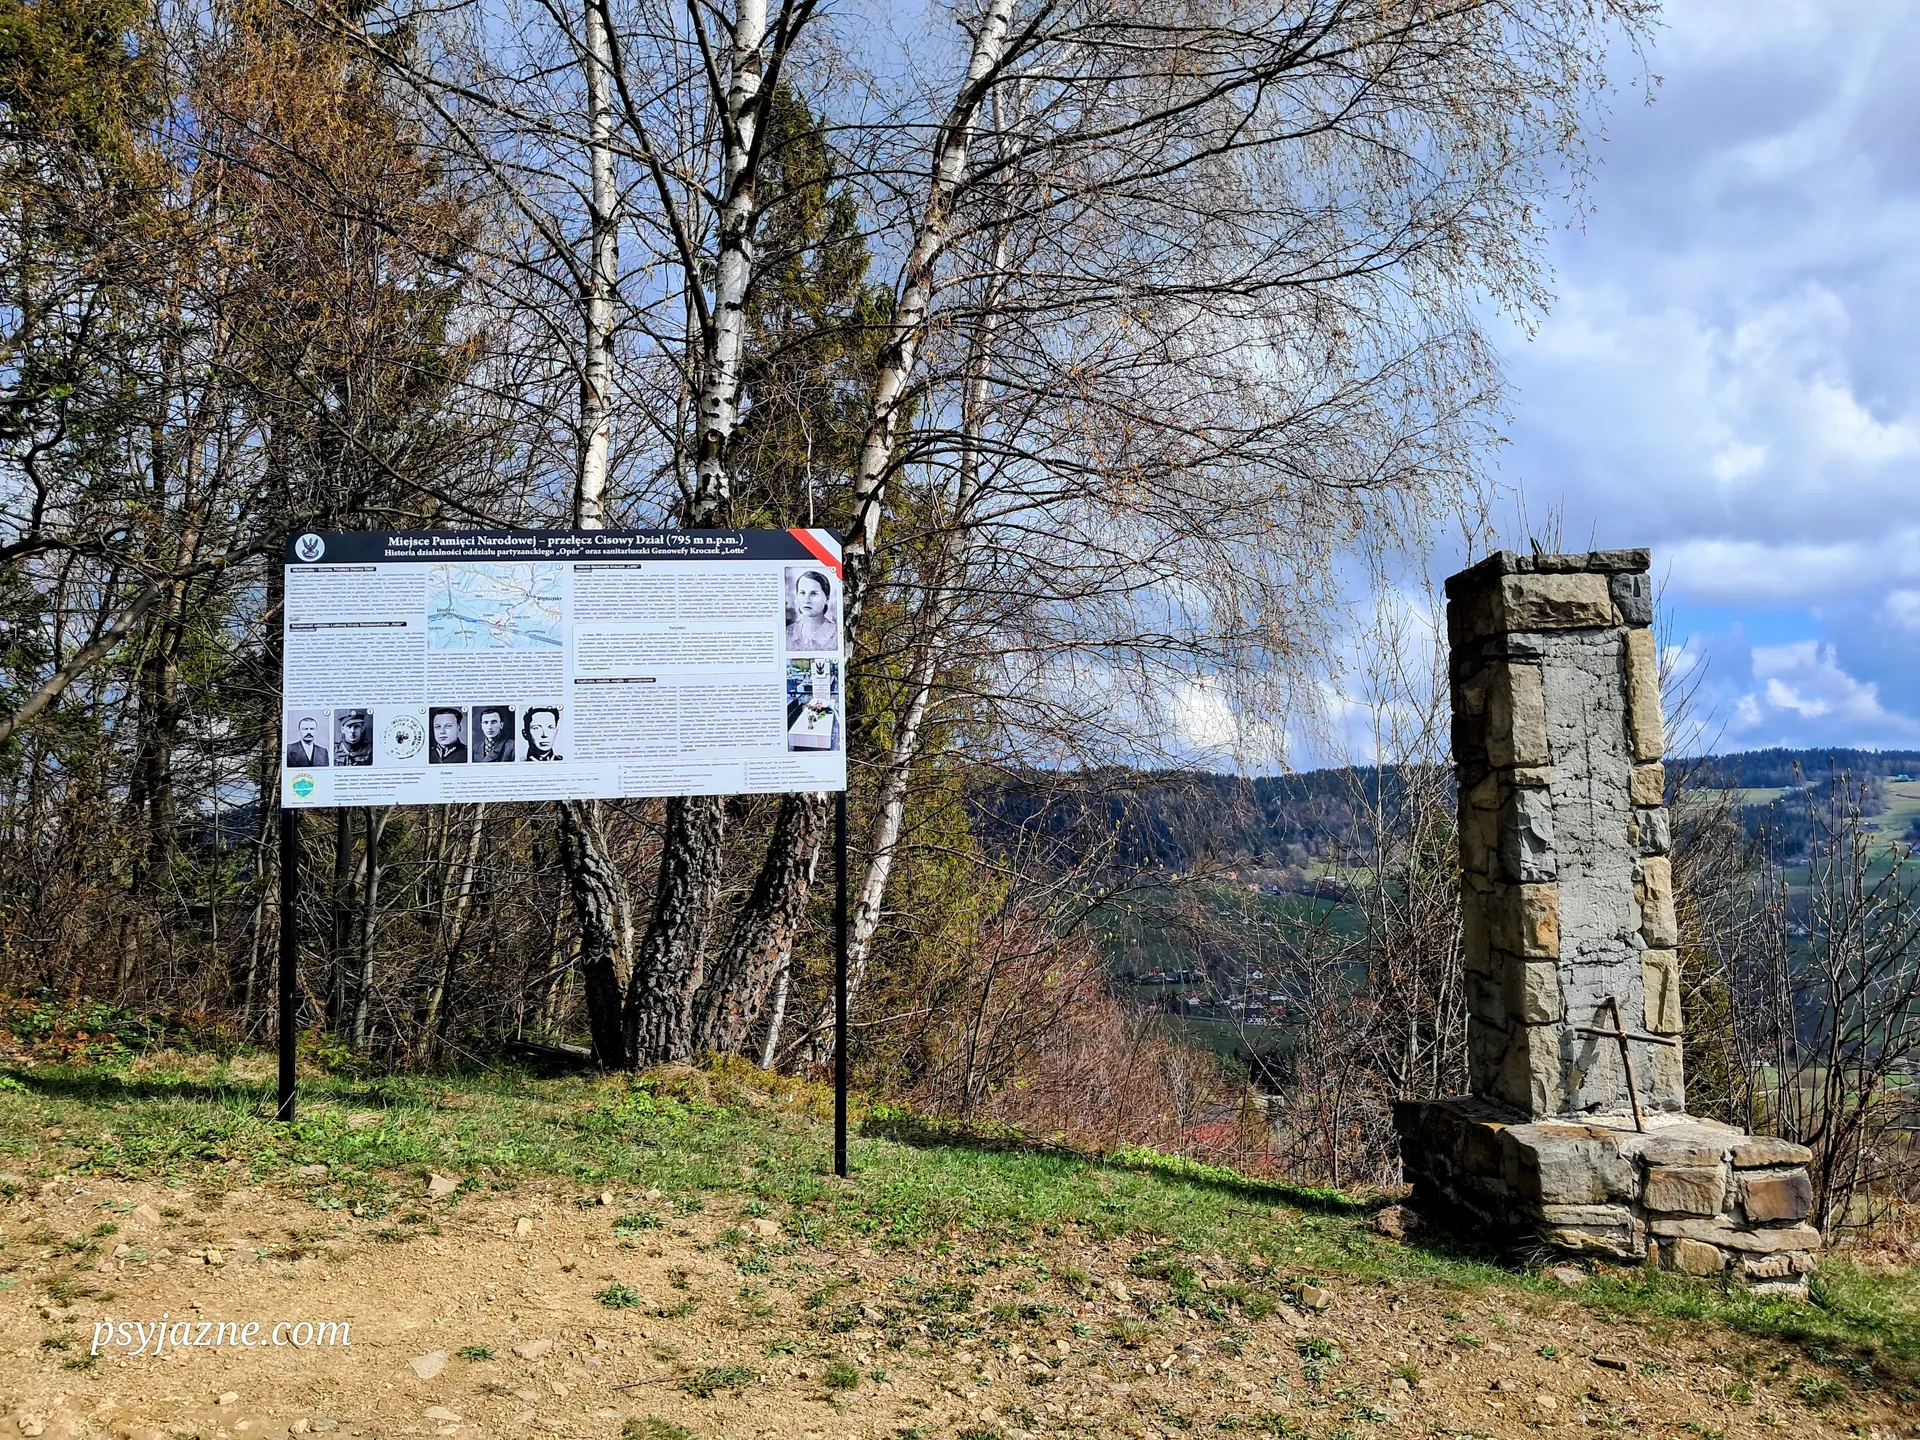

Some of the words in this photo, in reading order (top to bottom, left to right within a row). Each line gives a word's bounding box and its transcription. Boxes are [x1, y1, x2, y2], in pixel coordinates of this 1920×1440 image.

[388, 536, 430, 549] Miejsce
[432, 536, 475, 548] Pamięci
[477, 535, 537, 548] Narodowej
[548, 535, 593, 548] przełęcz
[594, 535, 634, 547] Cisowy
[636, 534, 664, 545] Dział
[666, 534, 692, 547] (795
[693, 537, 704, 545] m
[706, 534, 744, 547] n.p.m.)
[384, 549, 416, 557] Historia
[417, 548, 462, 556] działalności
[463, 548, 496, 556] oddziału
[497, 548, 555, 558] partyzanckiego
[603, 547, 650, 555] sanitariuszki
[651, 547, 689, 556] Genowefy
[690, 547, 720, 555] Kroczek
